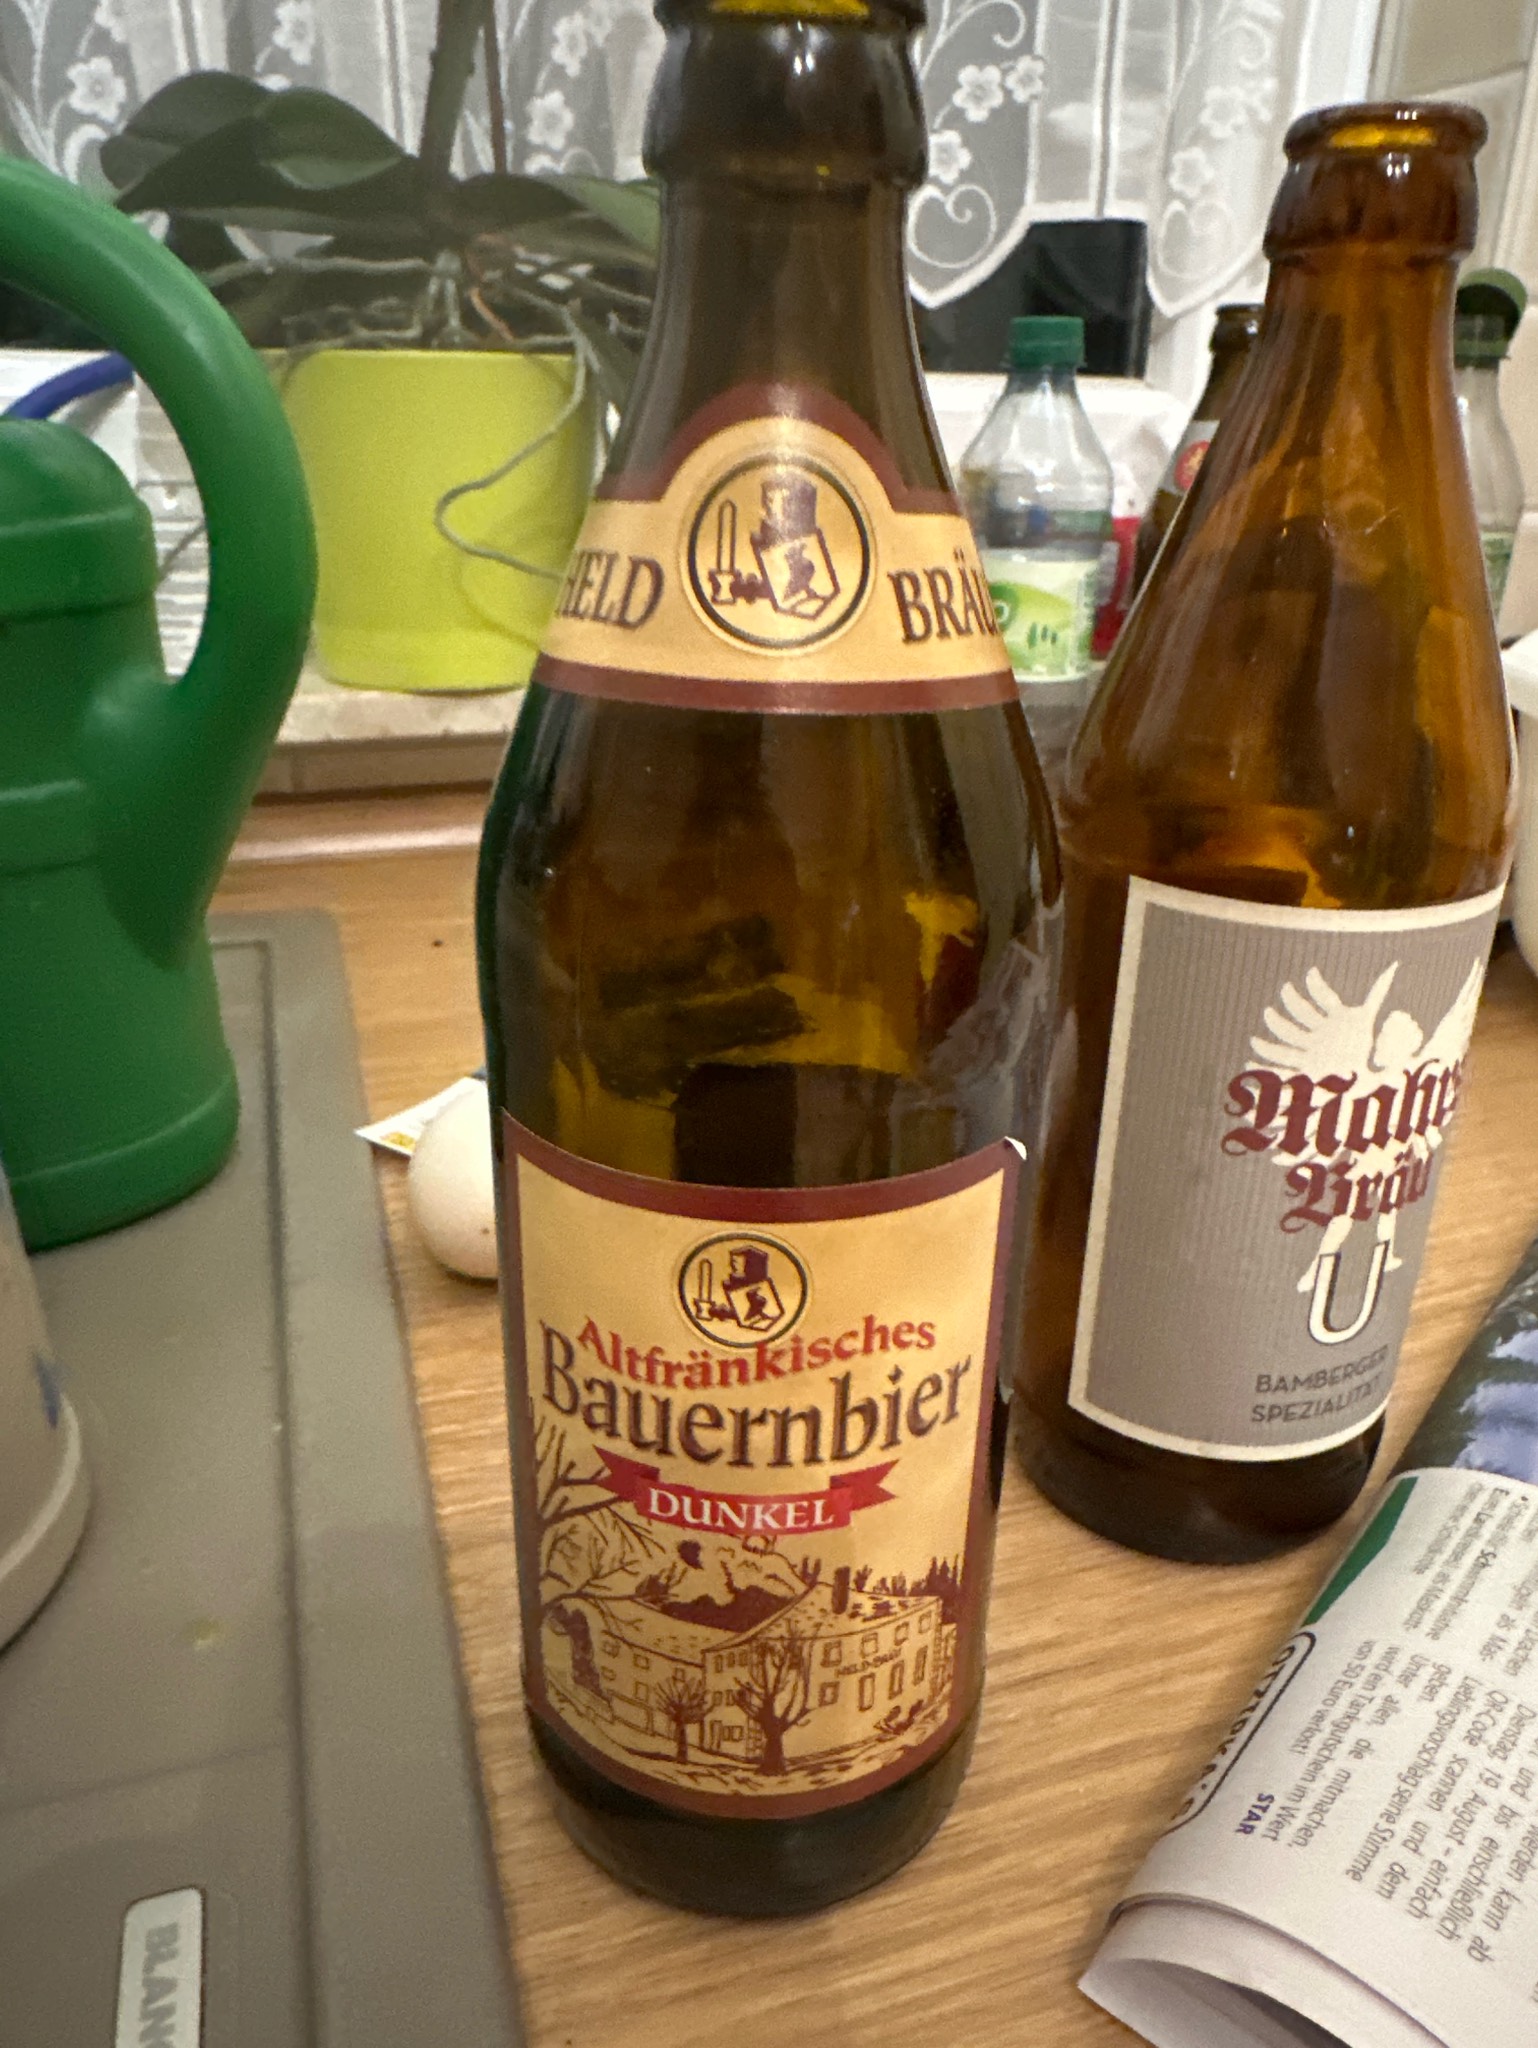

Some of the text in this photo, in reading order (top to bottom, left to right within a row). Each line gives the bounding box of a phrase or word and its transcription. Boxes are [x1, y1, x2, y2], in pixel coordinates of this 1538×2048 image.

[539, 1317, 971, 1468] Bauernbier
[576, 1314, 937, 1391] Altfränkisches
[648, 1487, 835, 1531] DUNKEL
[138, 1921, 180, 2048] BLAN
